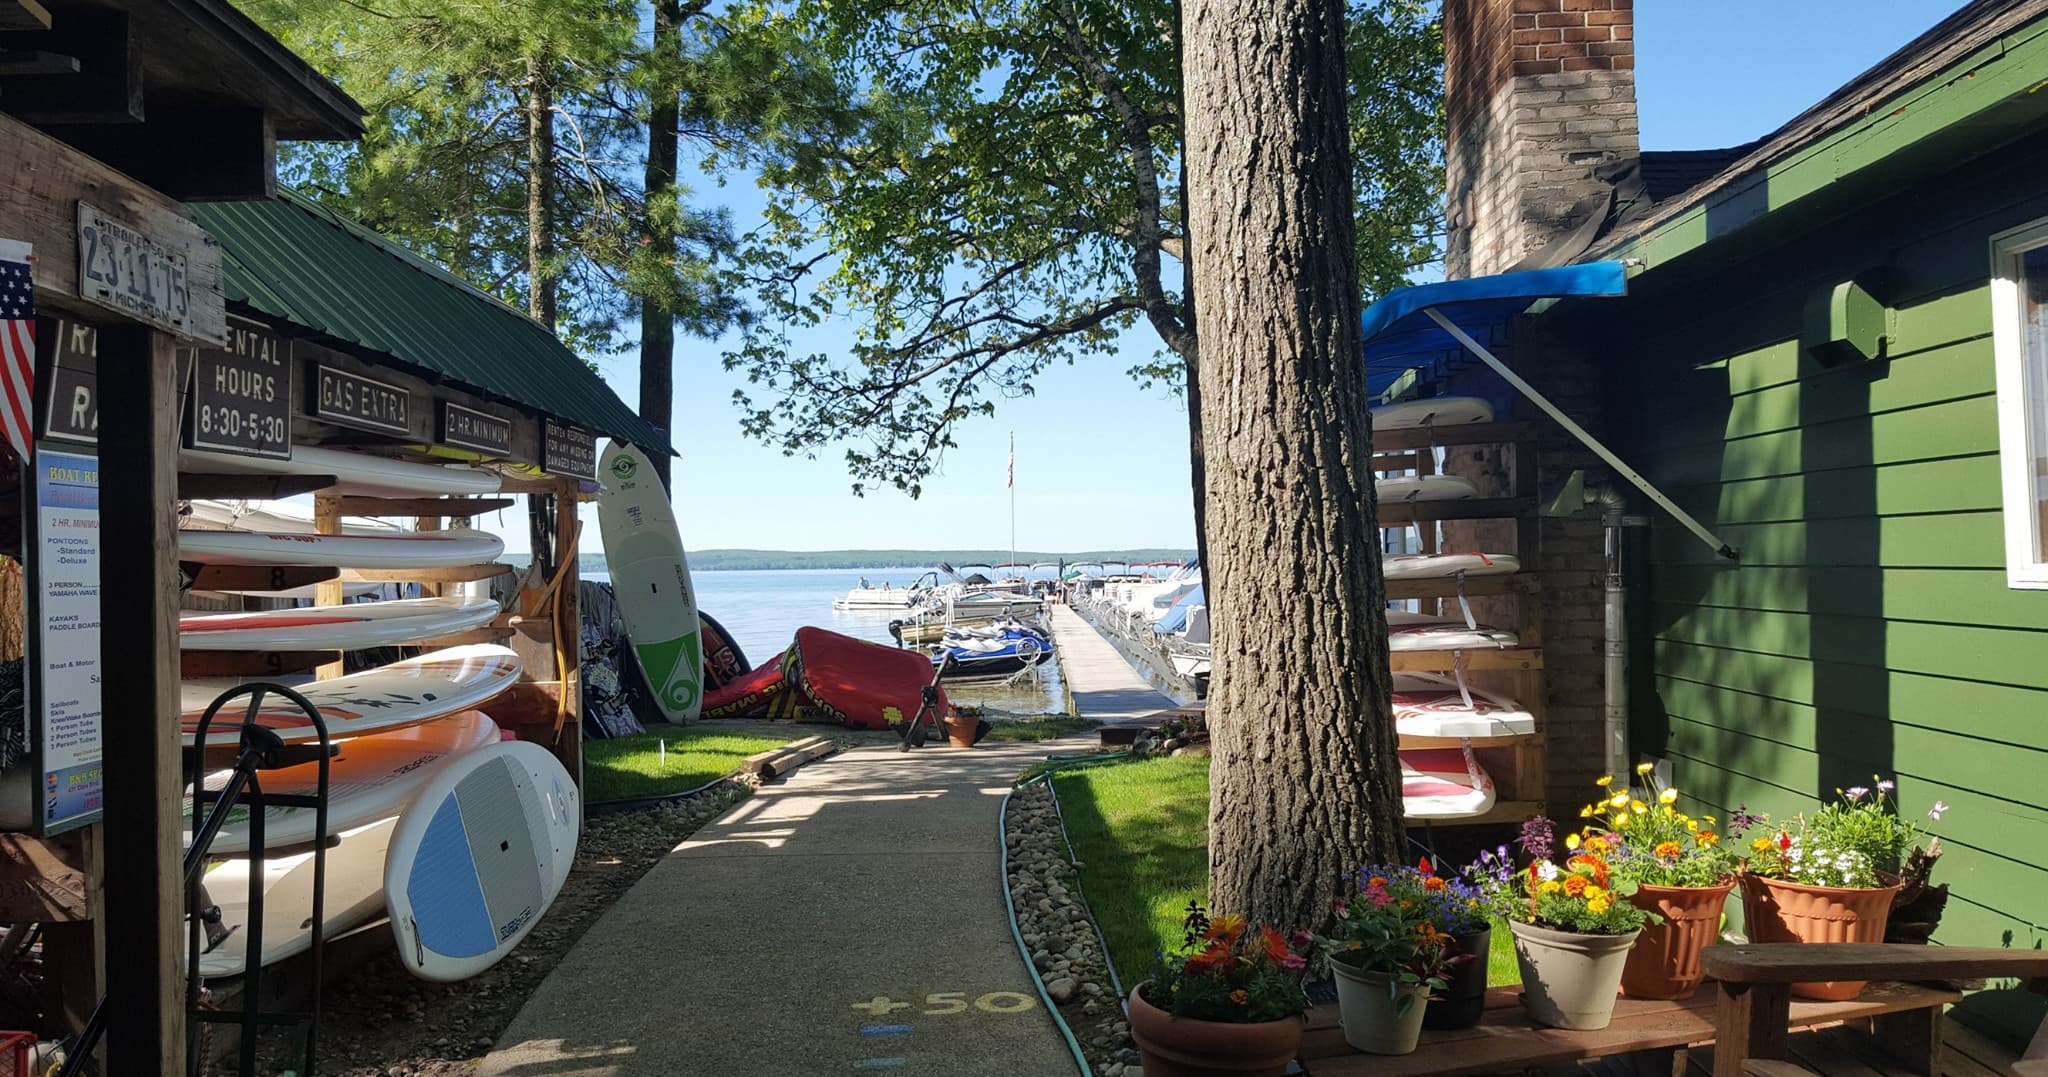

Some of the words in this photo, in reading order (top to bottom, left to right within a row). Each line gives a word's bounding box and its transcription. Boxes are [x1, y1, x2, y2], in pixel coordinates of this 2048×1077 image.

[114, 290, 170, 321] MICHIGAN
[224, 326, 281, 366] ENTAL
[215, 364, 275, 403] HOURS
[322, 375, 353, 411] GAS
[360, 382, 407, 424] EXTRA
[201, 404, 285, 444] 8:30-5:30
[449, 413, 456, 433] 2
[457, 418, 473, 436] HR.
[473, 419, 509, 445] MINIMUM
[49, 466, 80, 483] BOAT
[73, 519, 100, 529] MINIMU
[47, 537, 89, 545] PONTOONS
[48, 590, 79, 598] YAMAHA
[49, 663, 68, 671] Boat
